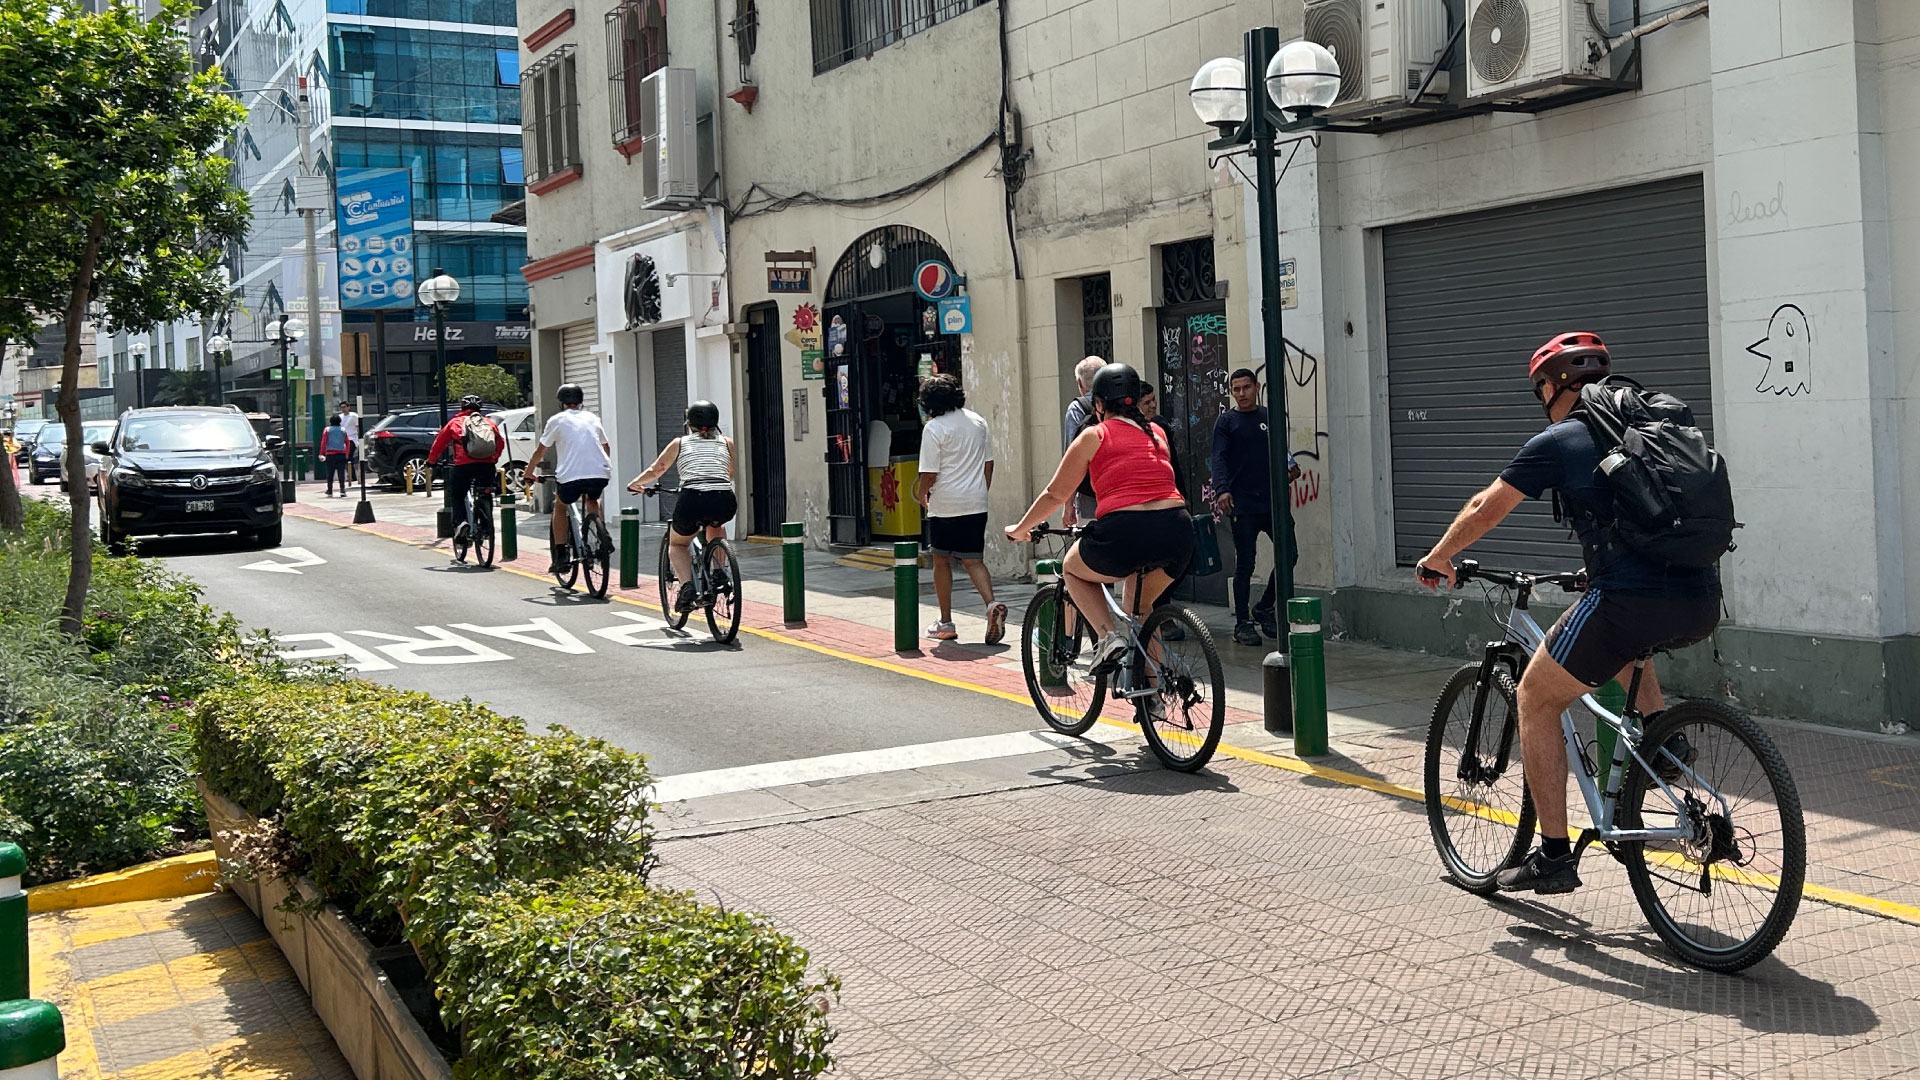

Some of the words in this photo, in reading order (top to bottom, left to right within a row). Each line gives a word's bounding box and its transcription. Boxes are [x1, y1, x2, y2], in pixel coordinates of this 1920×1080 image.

[947, 316, 963, 325] plin
[414, 326, 464, 341] Hetz
[499, 349, 525, 359] Hertz
[241, 611, 718, 672] PARE
